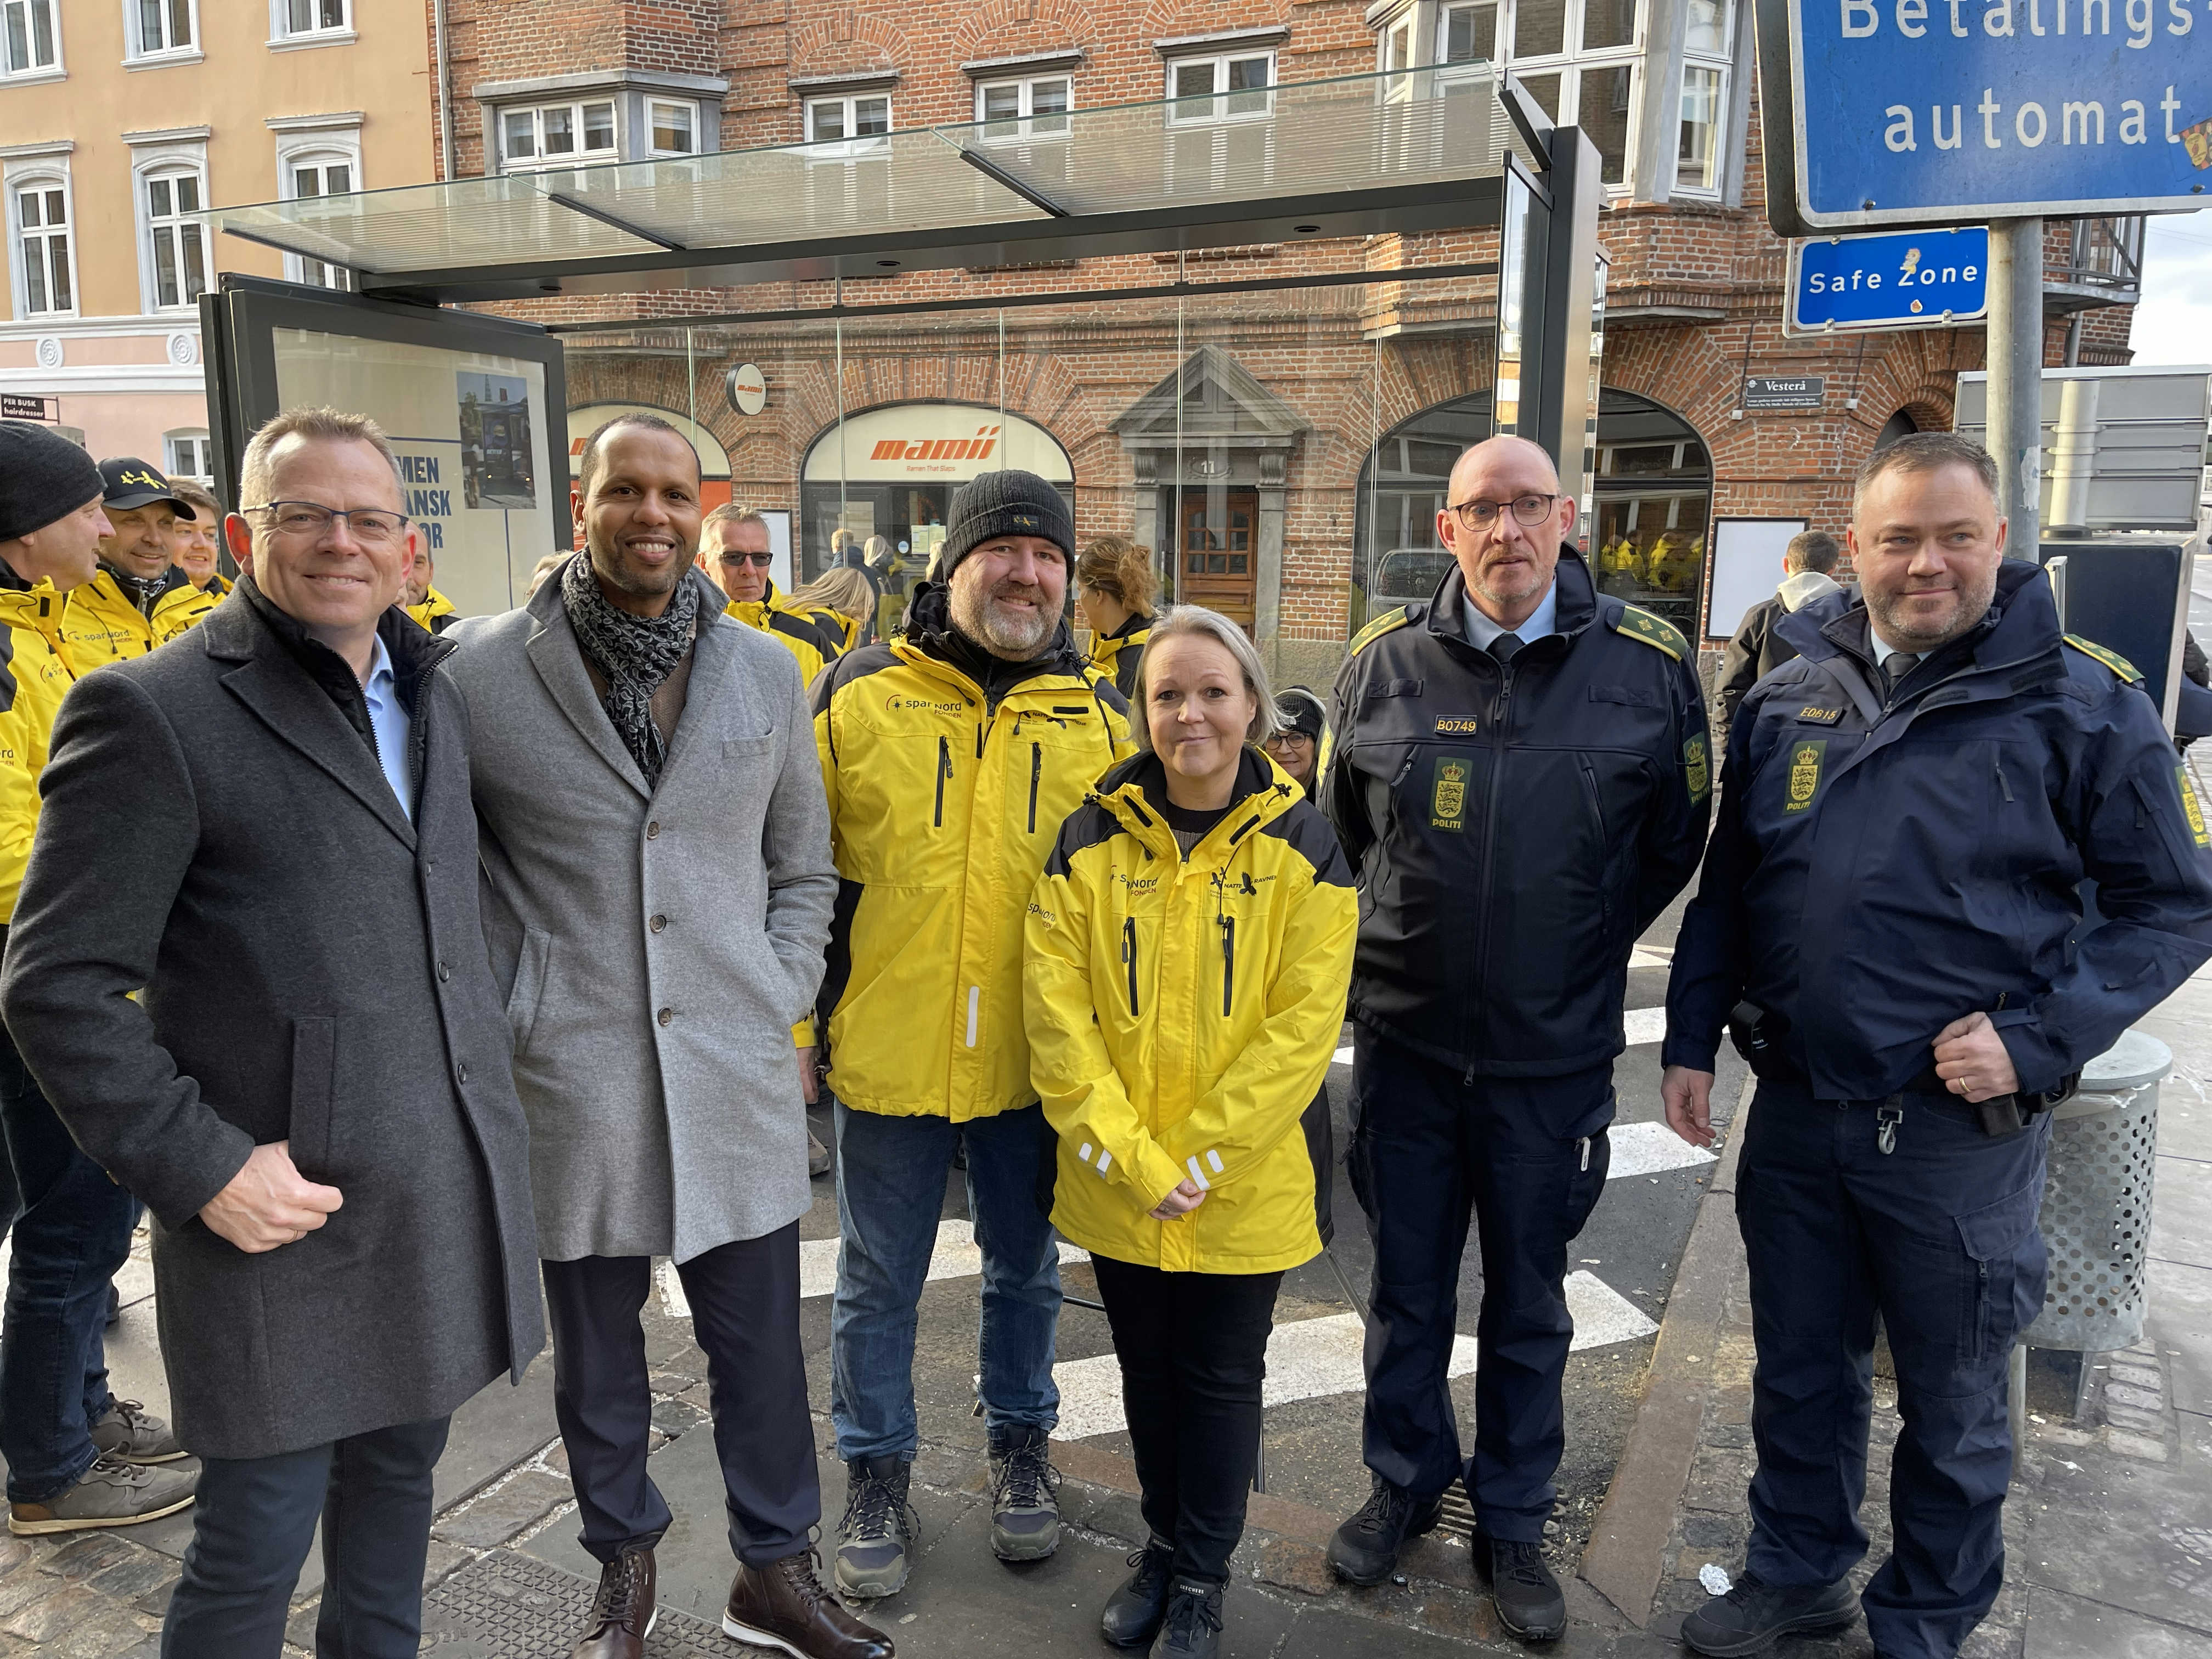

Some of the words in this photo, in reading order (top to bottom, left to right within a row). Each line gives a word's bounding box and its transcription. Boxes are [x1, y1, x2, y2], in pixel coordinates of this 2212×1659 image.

[1841, 0, 2211, 49] Betalings
[1883, 86, 2182, 153] automat
[1809, 269, 1882, 294] Safe
[1898, 265, 1978, 287] Zone
[1765, 380, 1807, 391] Vesterå
[18, 399, 36, 407] BUSK
[4, 407, 44, 417] hairdresser
[870, 425, 1001, 460] mamii
[84, 632, 105, 641] spar
[905, 700, 933, 710] spar
[934, 702, 962, 712] Nord
[1432, 818, 1461, 829] POLITI
[1132, 876, 1159, 888] Nord
